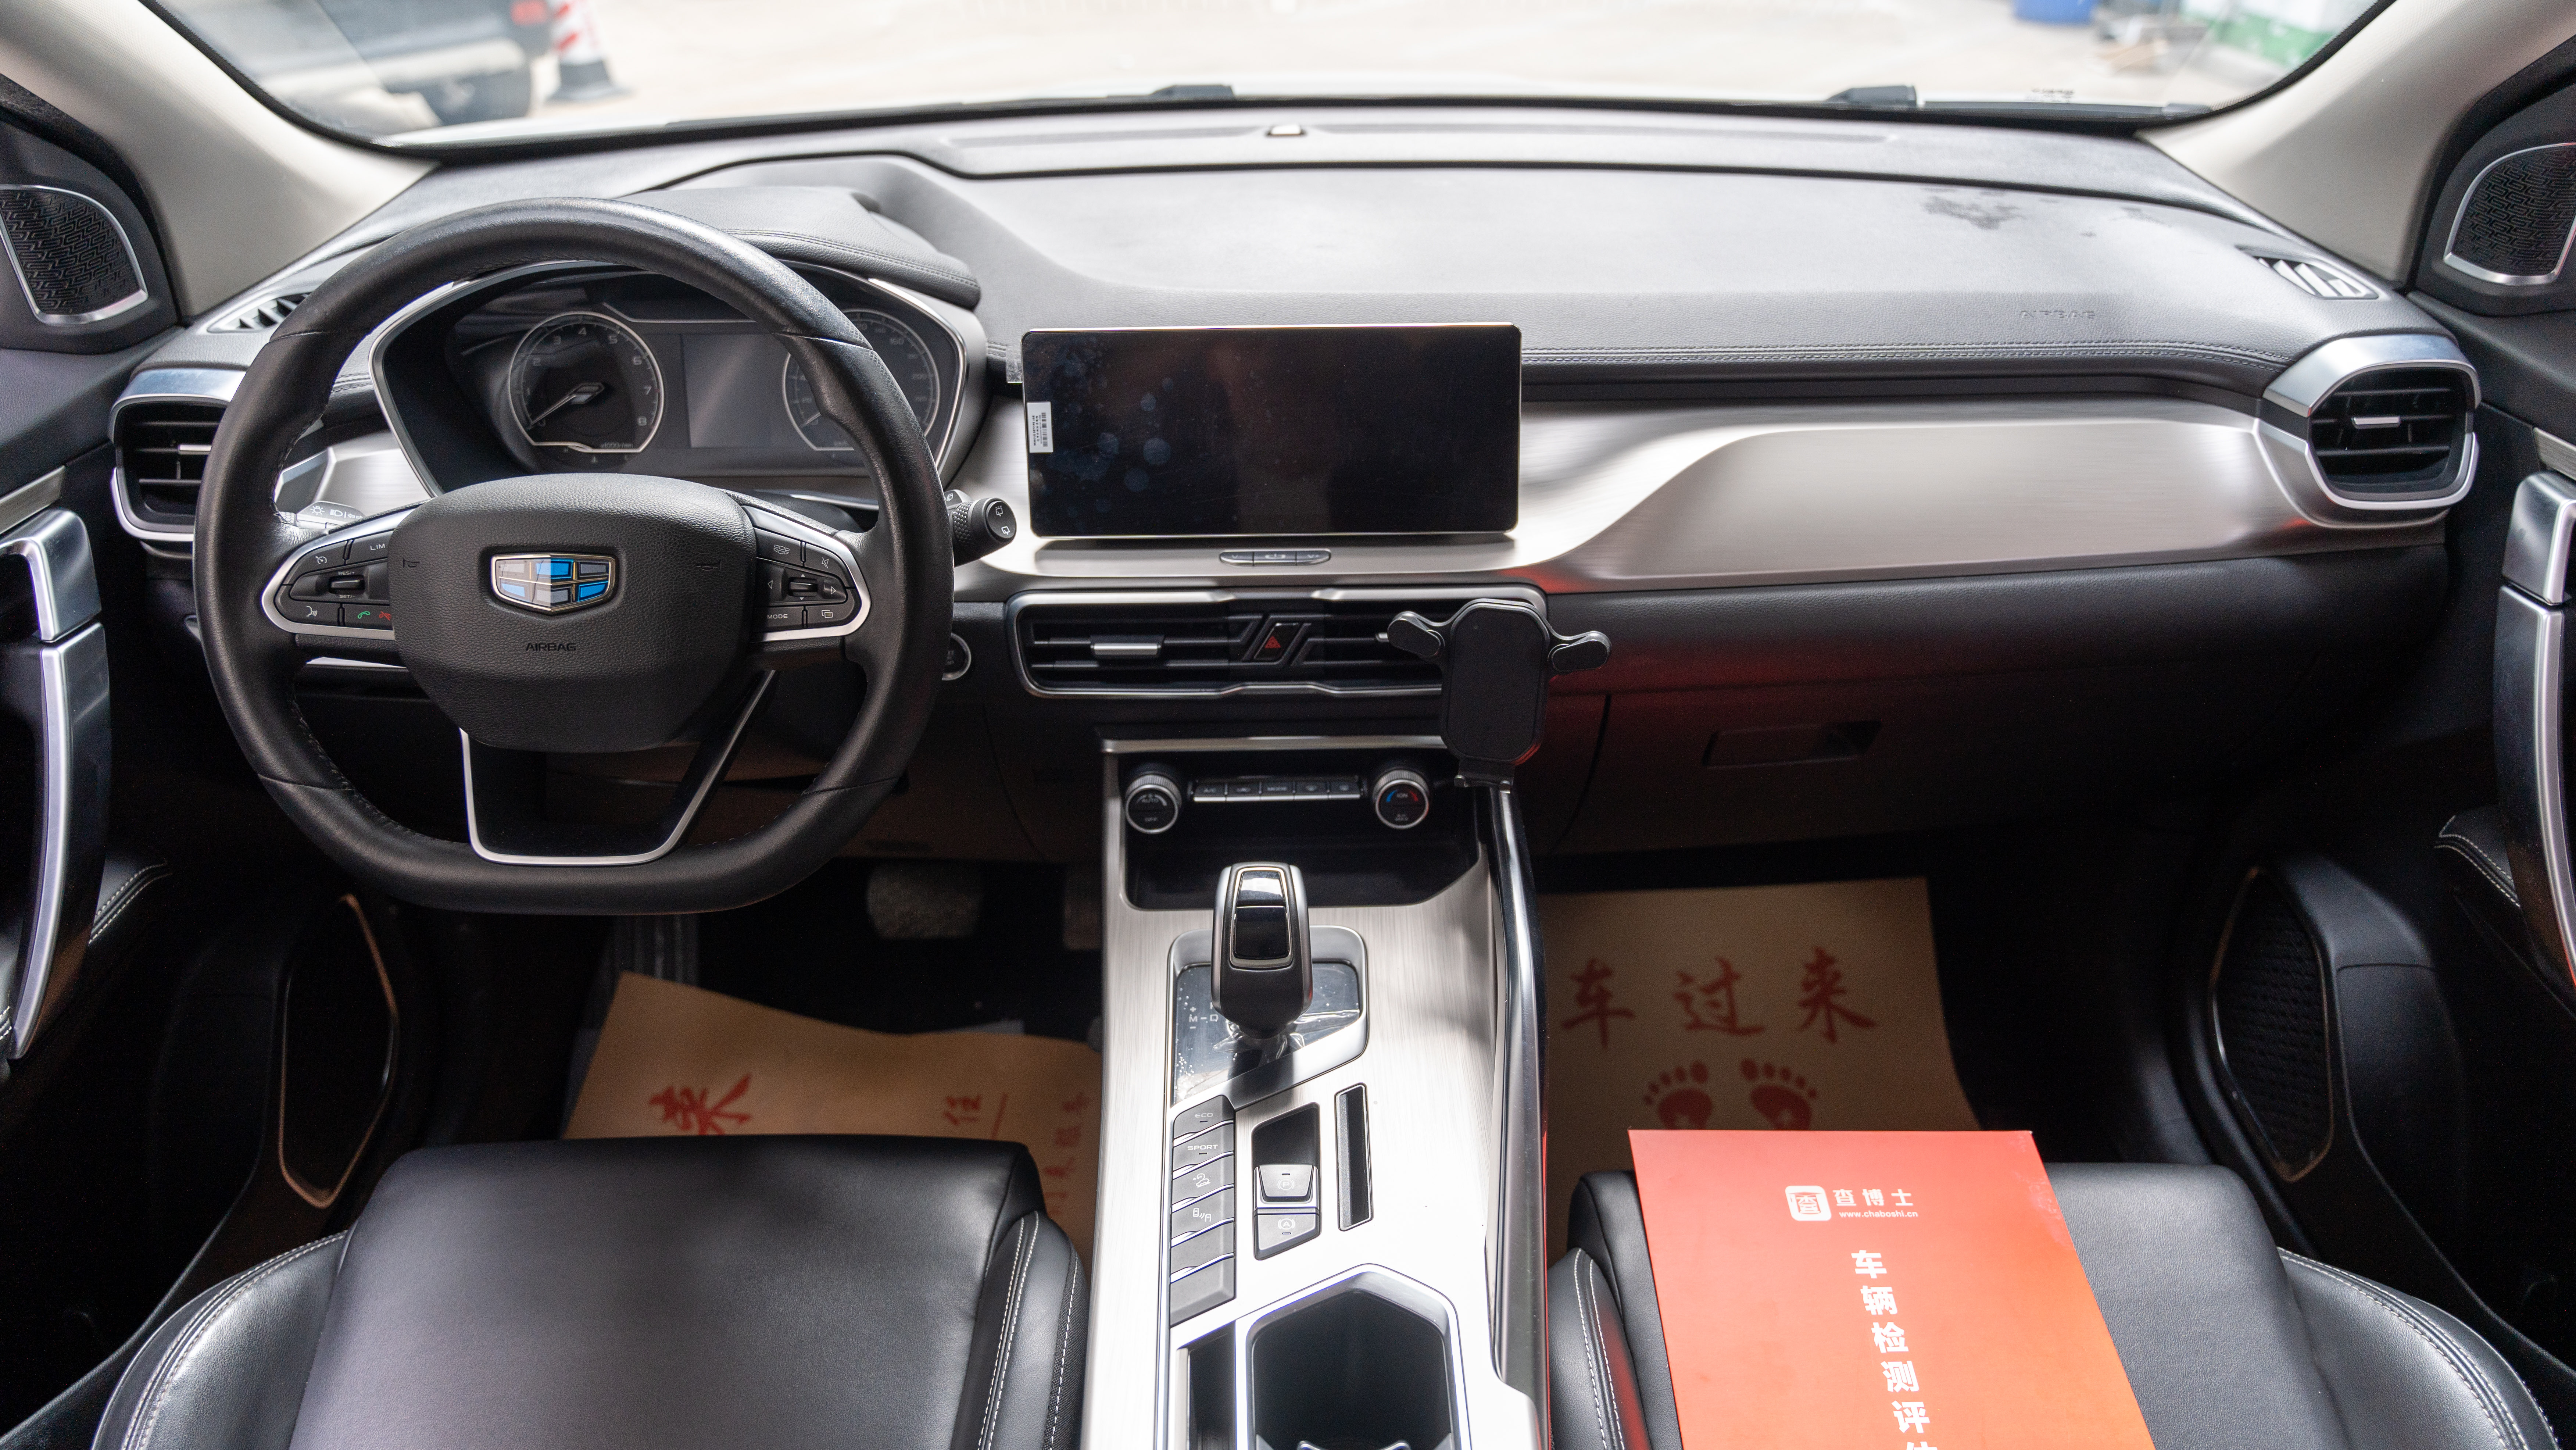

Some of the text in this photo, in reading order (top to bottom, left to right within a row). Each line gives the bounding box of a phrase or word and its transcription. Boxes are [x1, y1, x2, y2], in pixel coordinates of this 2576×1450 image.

[578, 327, 587, 336] 4
[553, 335, 561, 344] 3
[608, 334, 618, 344] 5
[533, 357, 541, 366] 2
[633, 356, 642, 365] 6
[644, 385, 652, 395] 7
[637, 416, 647, 426] 8
[526, 643, 577, 651] AIRBAG
[1832, 1189, 1914, 1206] 查博士
[1851, 1250, 1938, 1450] 车辆检测评
